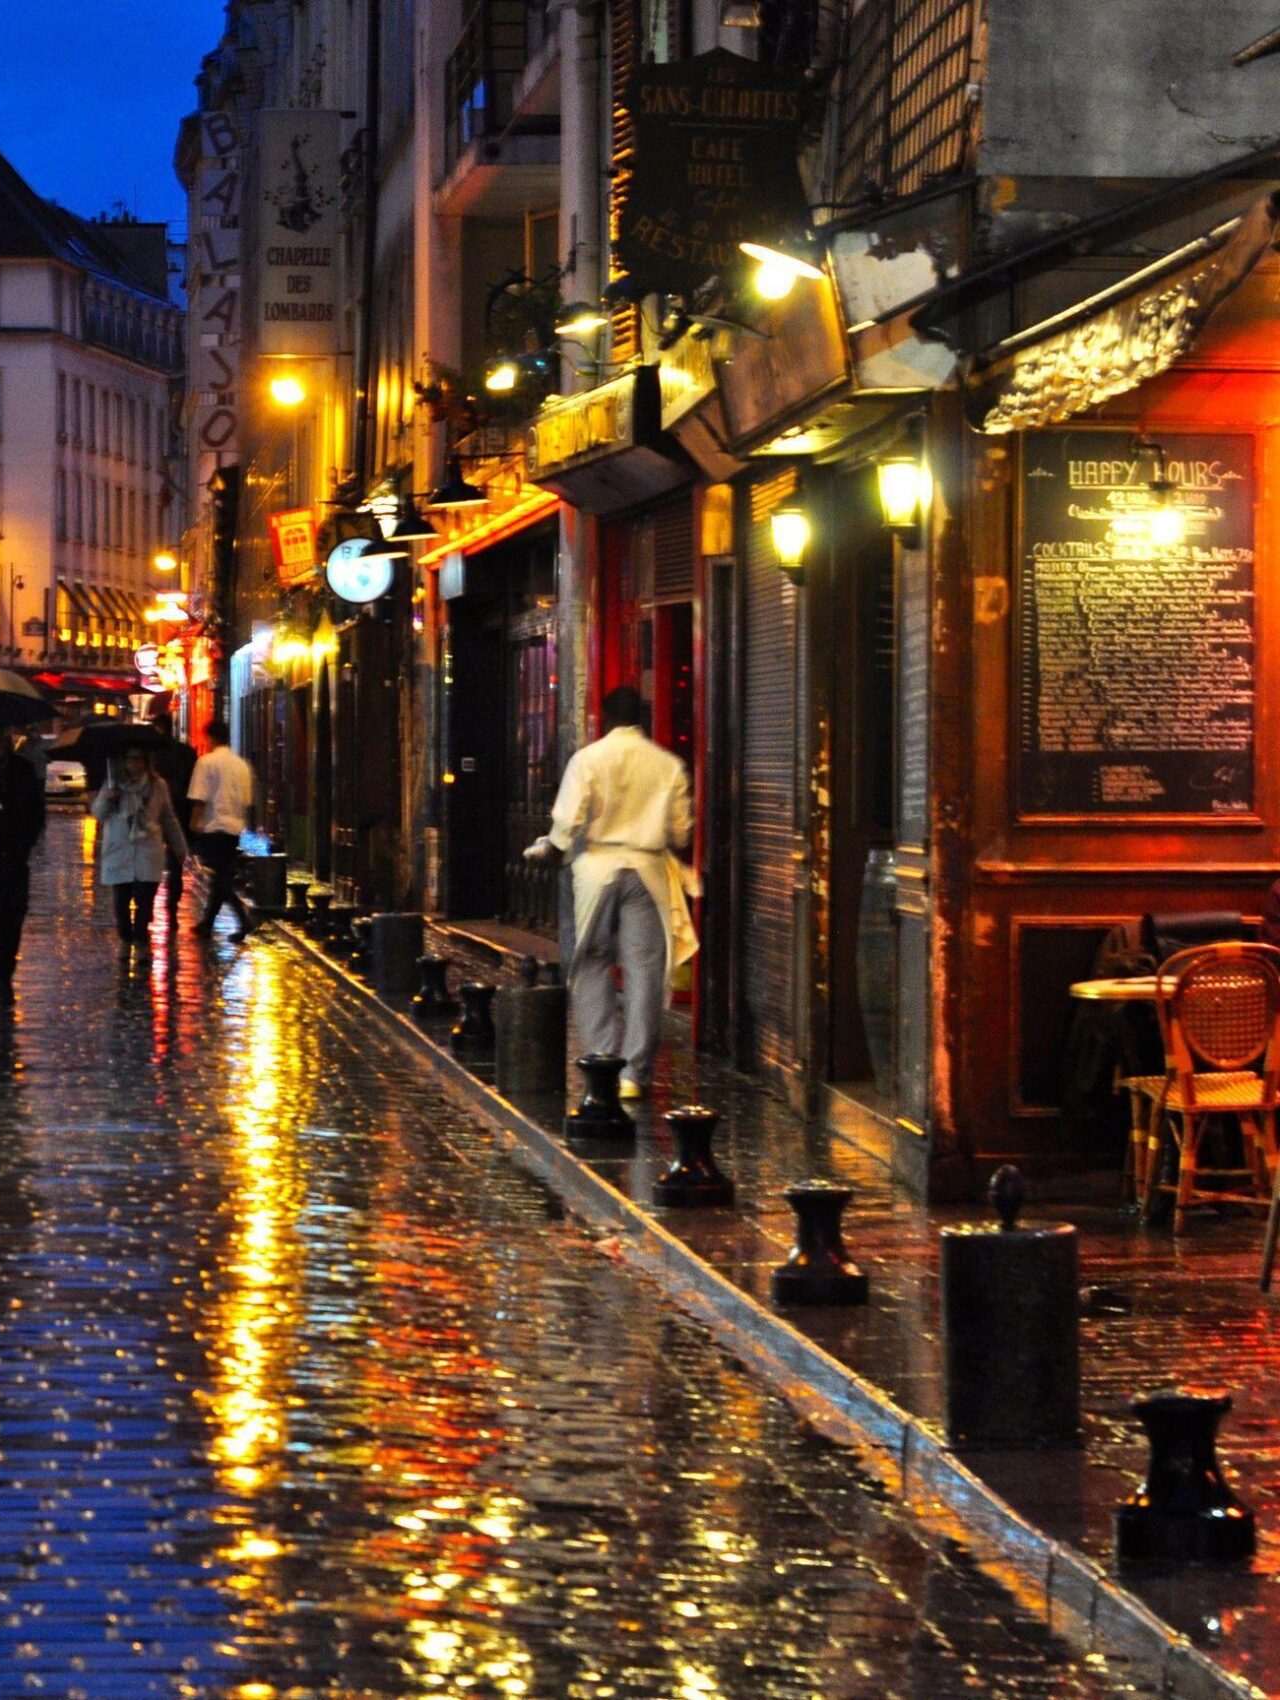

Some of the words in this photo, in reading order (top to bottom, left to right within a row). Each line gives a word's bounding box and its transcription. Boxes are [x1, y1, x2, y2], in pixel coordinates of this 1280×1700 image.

[266, 246, 331, 267] CHAPELLE
[200, 112, 238, 448] BALAJO
[286, 274, 311, 294] DES
[264, 301, 334, 322] LOMBARDS
[1068, 461, 1138, 485] HAPPY
[1153, 461, 1223, 485] HOURS
